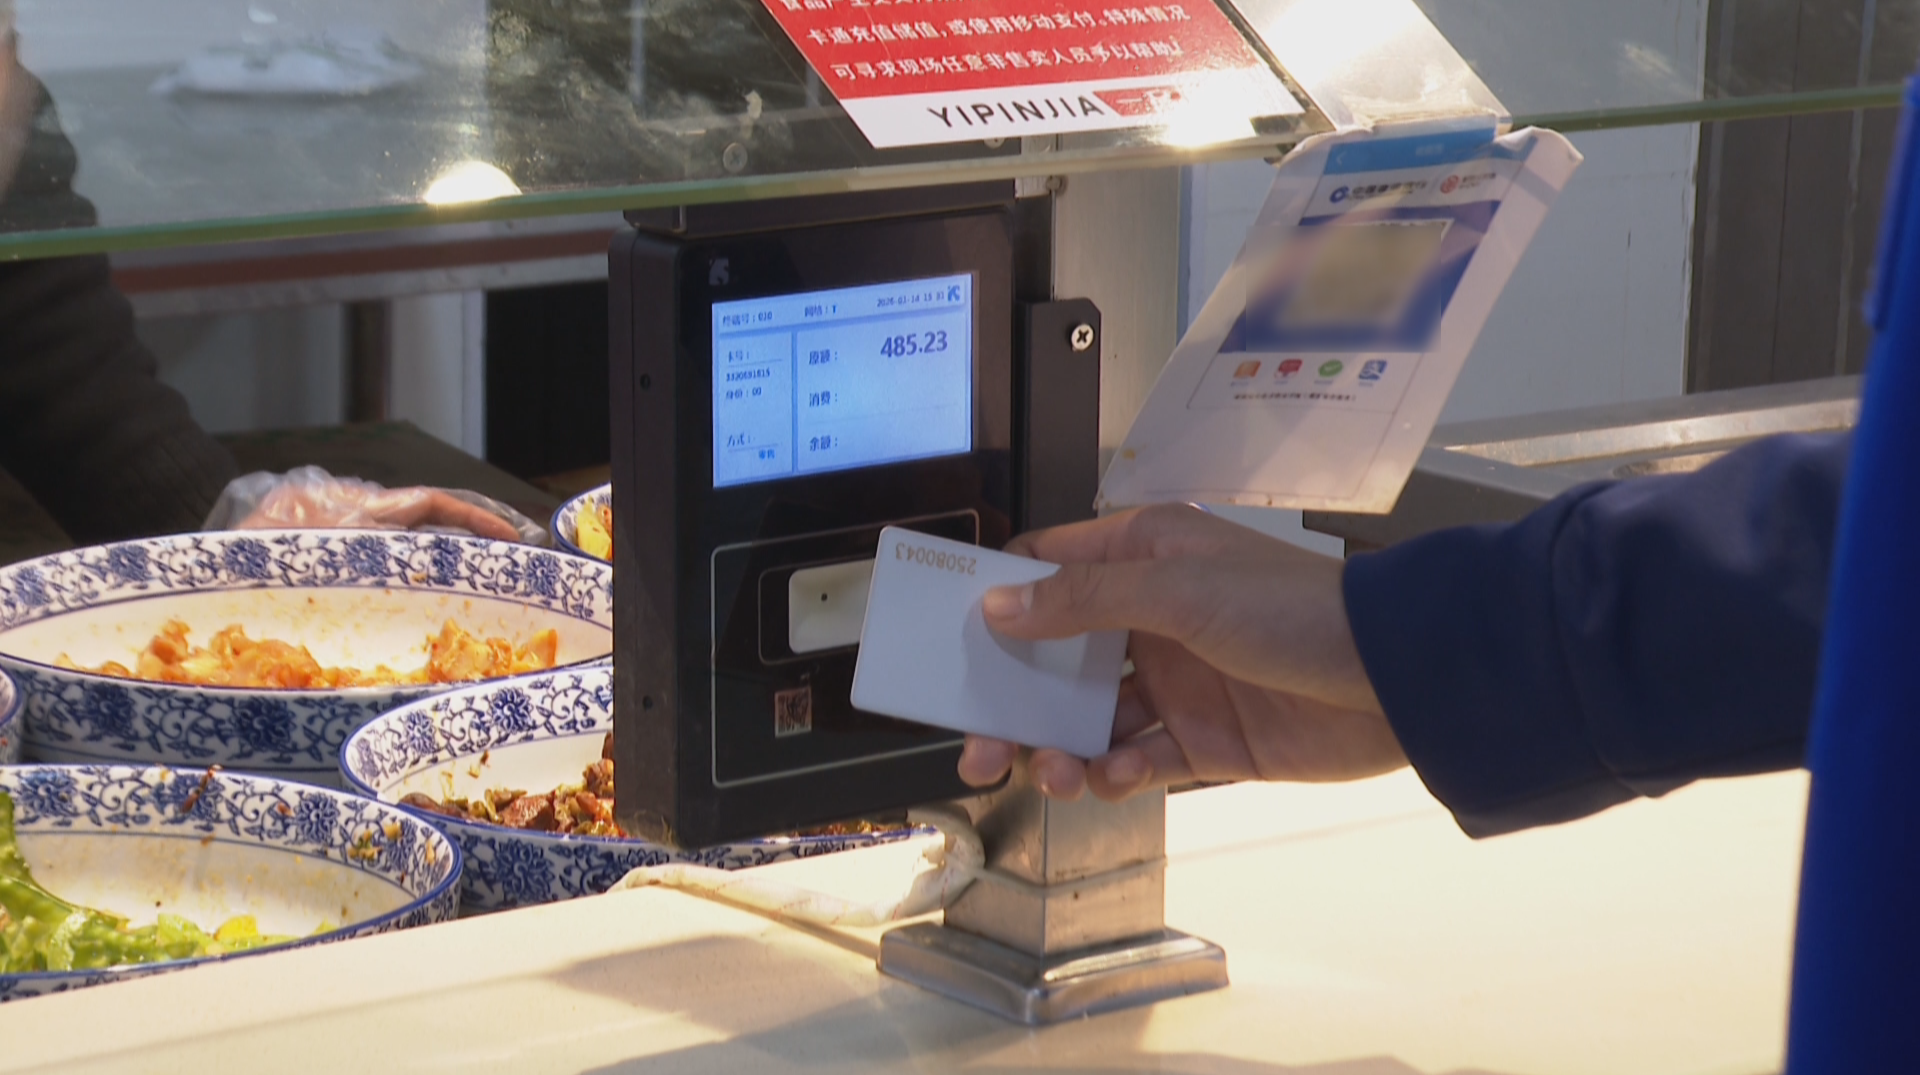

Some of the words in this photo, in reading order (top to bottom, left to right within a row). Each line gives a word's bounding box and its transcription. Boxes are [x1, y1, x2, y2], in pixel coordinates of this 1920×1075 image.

[927, 94, 1105, 128] YIPINJIA
[880, 330, 948, 358] 485.23
[808, 390, 838, 407] 消费：
[895, 541, 977, 576] 25080043
